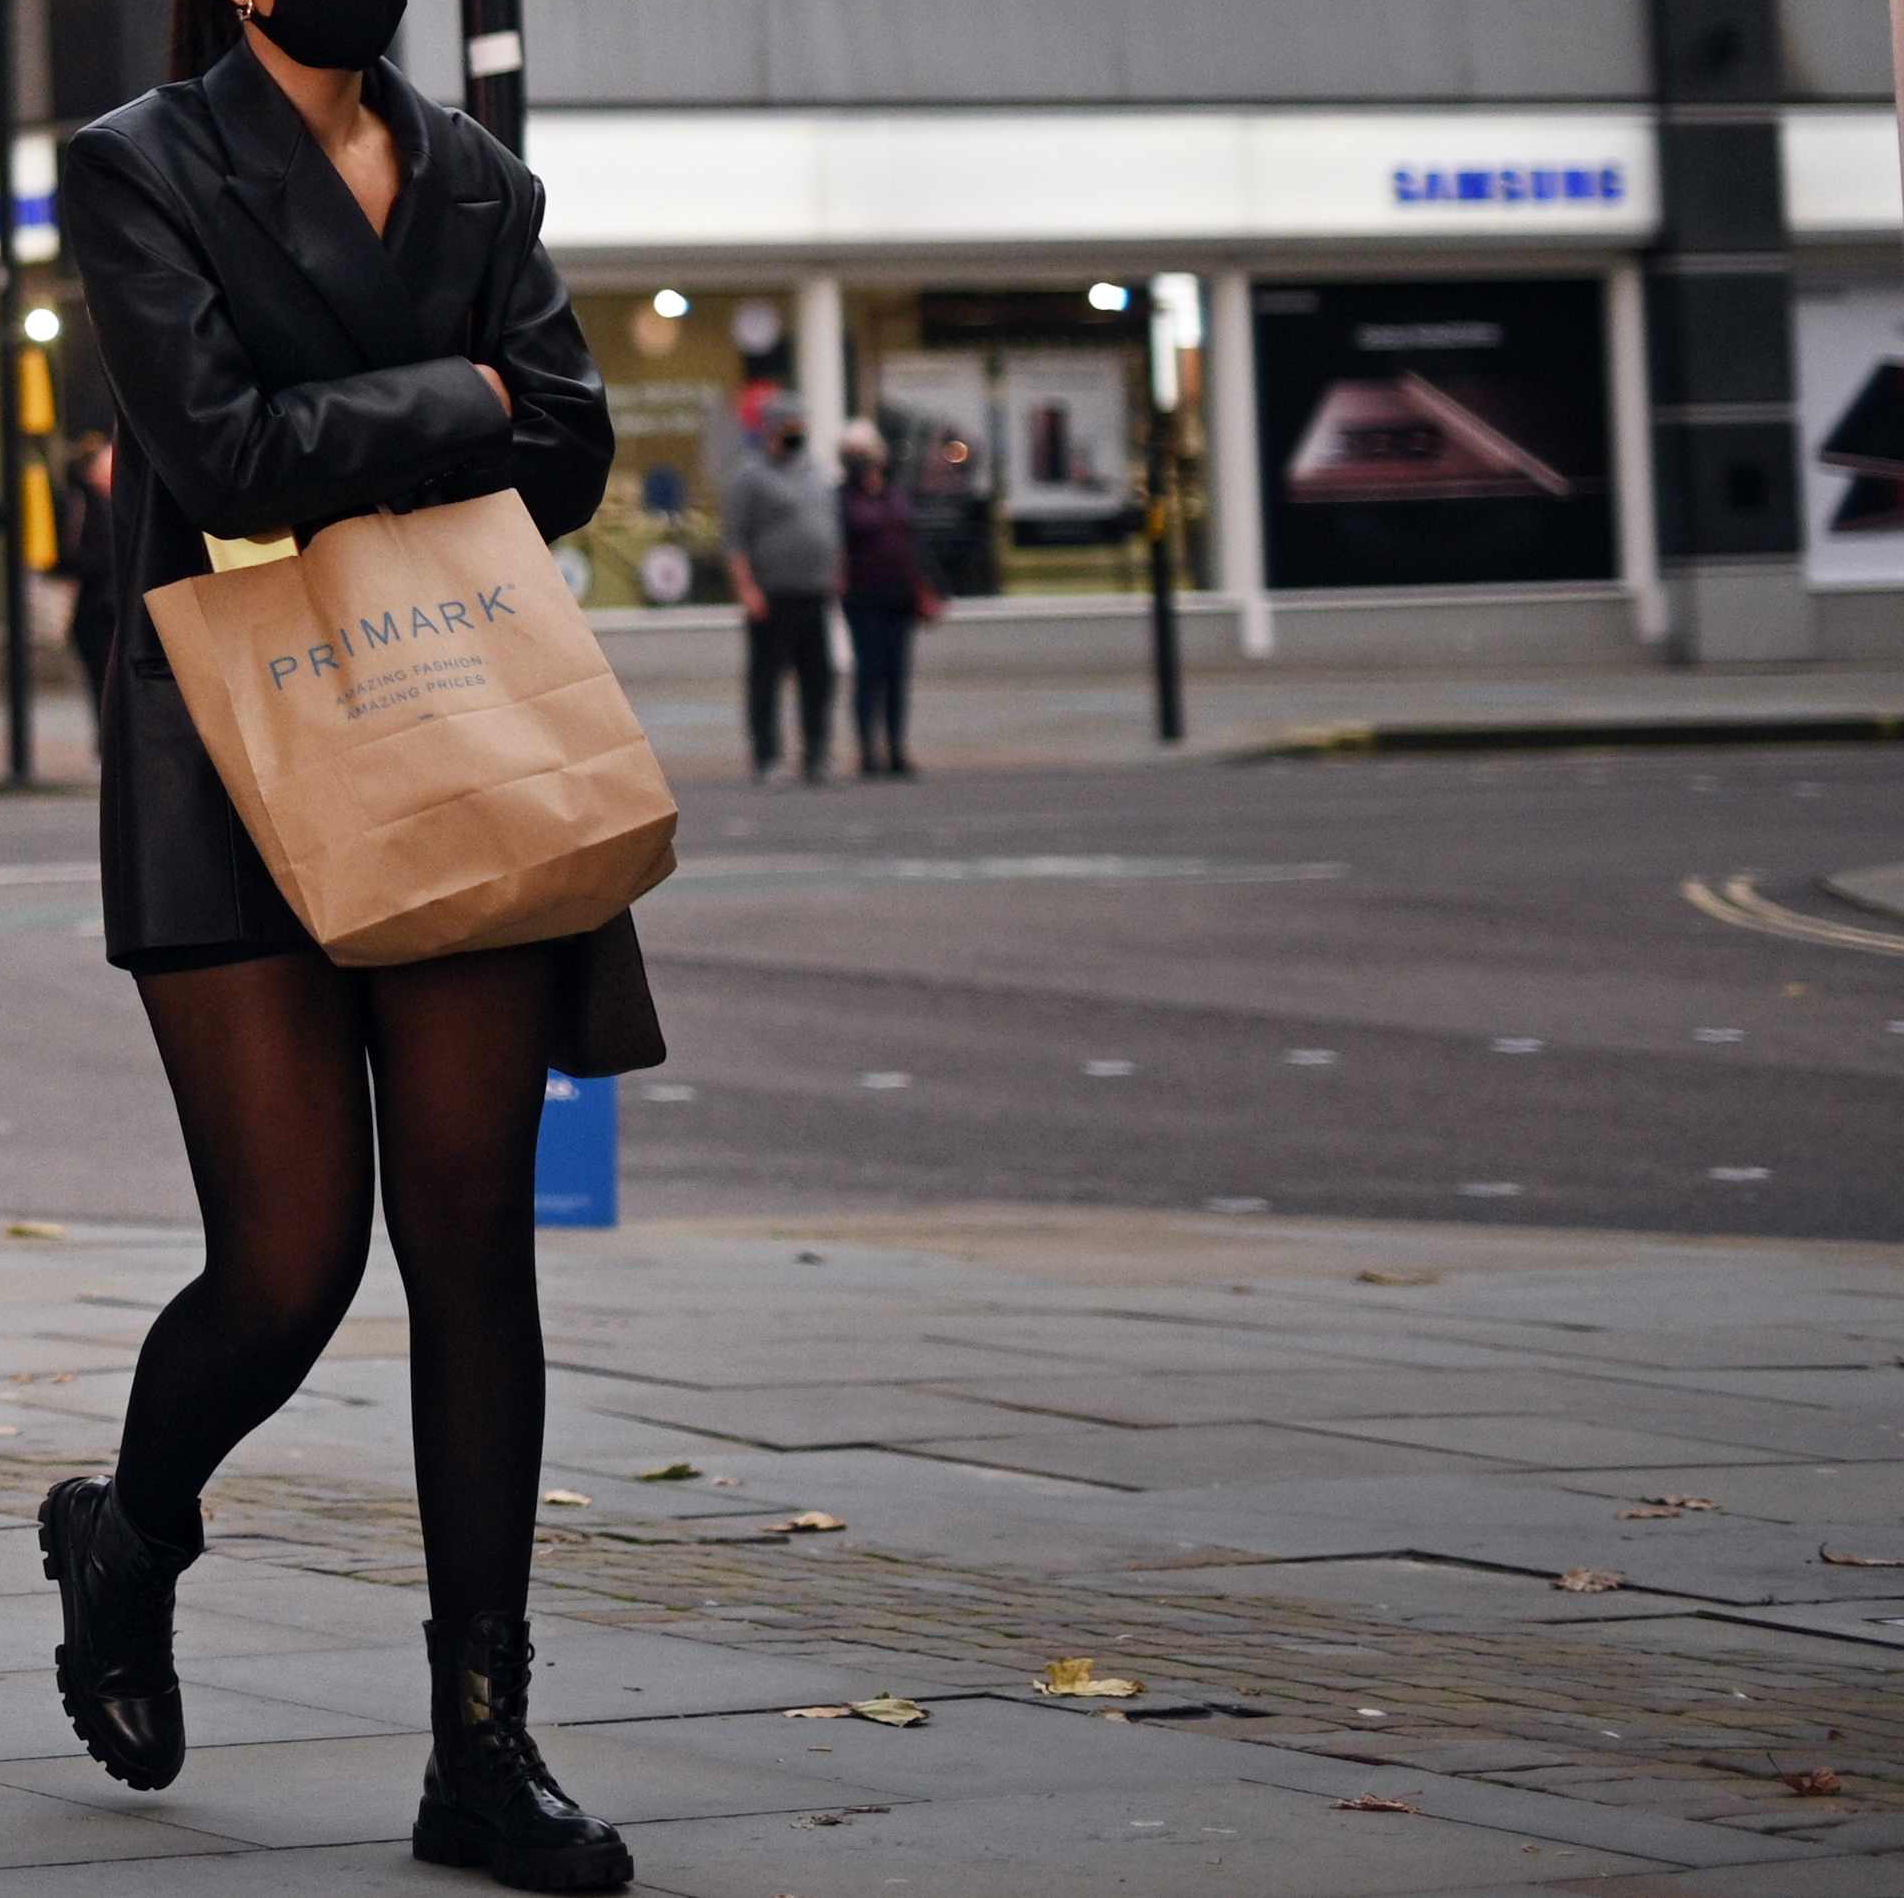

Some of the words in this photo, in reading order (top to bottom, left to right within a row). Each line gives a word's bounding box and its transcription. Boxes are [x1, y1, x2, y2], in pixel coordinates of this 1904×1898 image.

[1394, 168, 1624, 204] SAMSUNG
[269, 586, 515, 690] PRIMARK
[337, 670, 407, 705] AMAZING
[347, 687, 420, 720] AMAZING
[427, 674, 486, 694] PRICES
